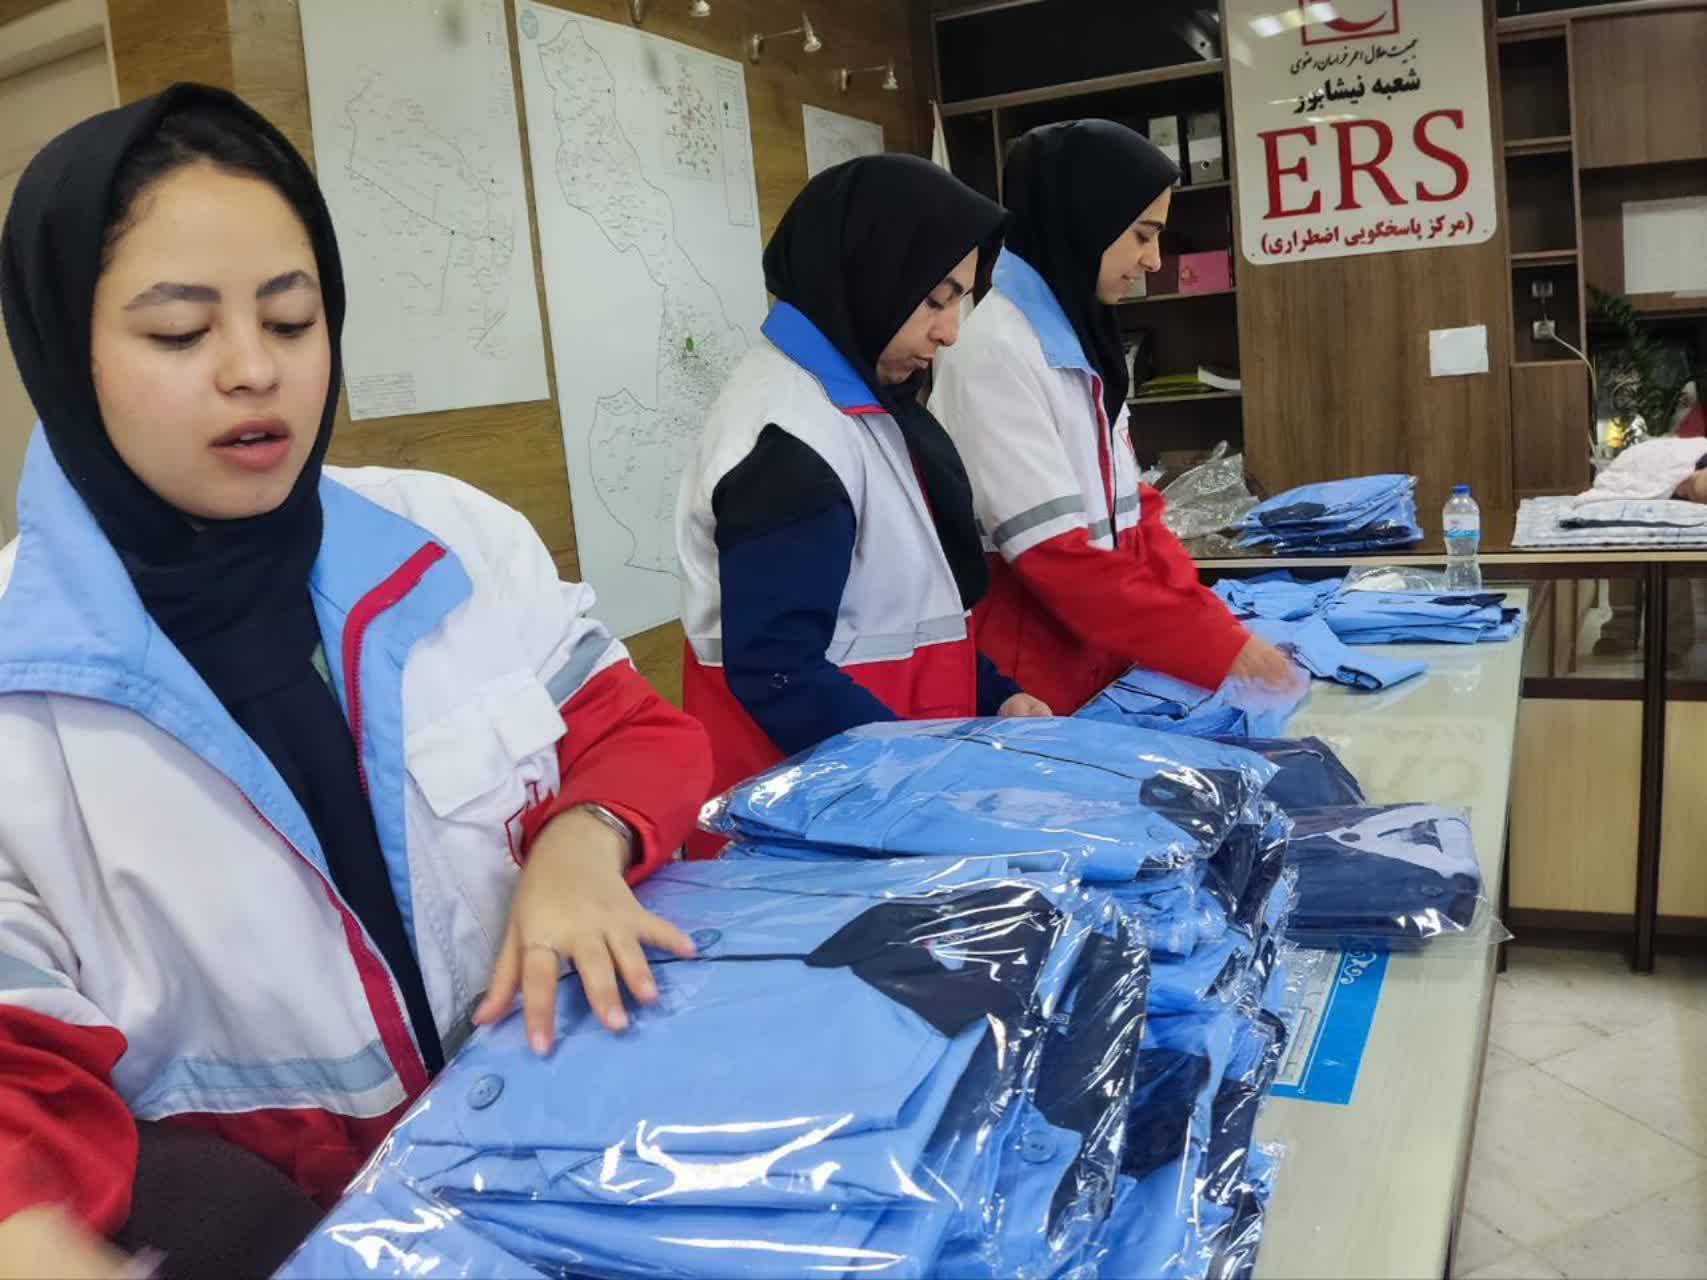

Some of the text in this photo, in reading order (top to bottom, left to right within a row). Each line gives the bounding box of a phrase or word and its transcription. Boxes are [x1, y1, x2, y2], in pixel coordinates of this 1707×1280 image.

[1371, 67, 1421, 101] شعبه
[1257, 109, 1469, 220] ERS
[1343, 216, 1423, 247] پاسخگویی
